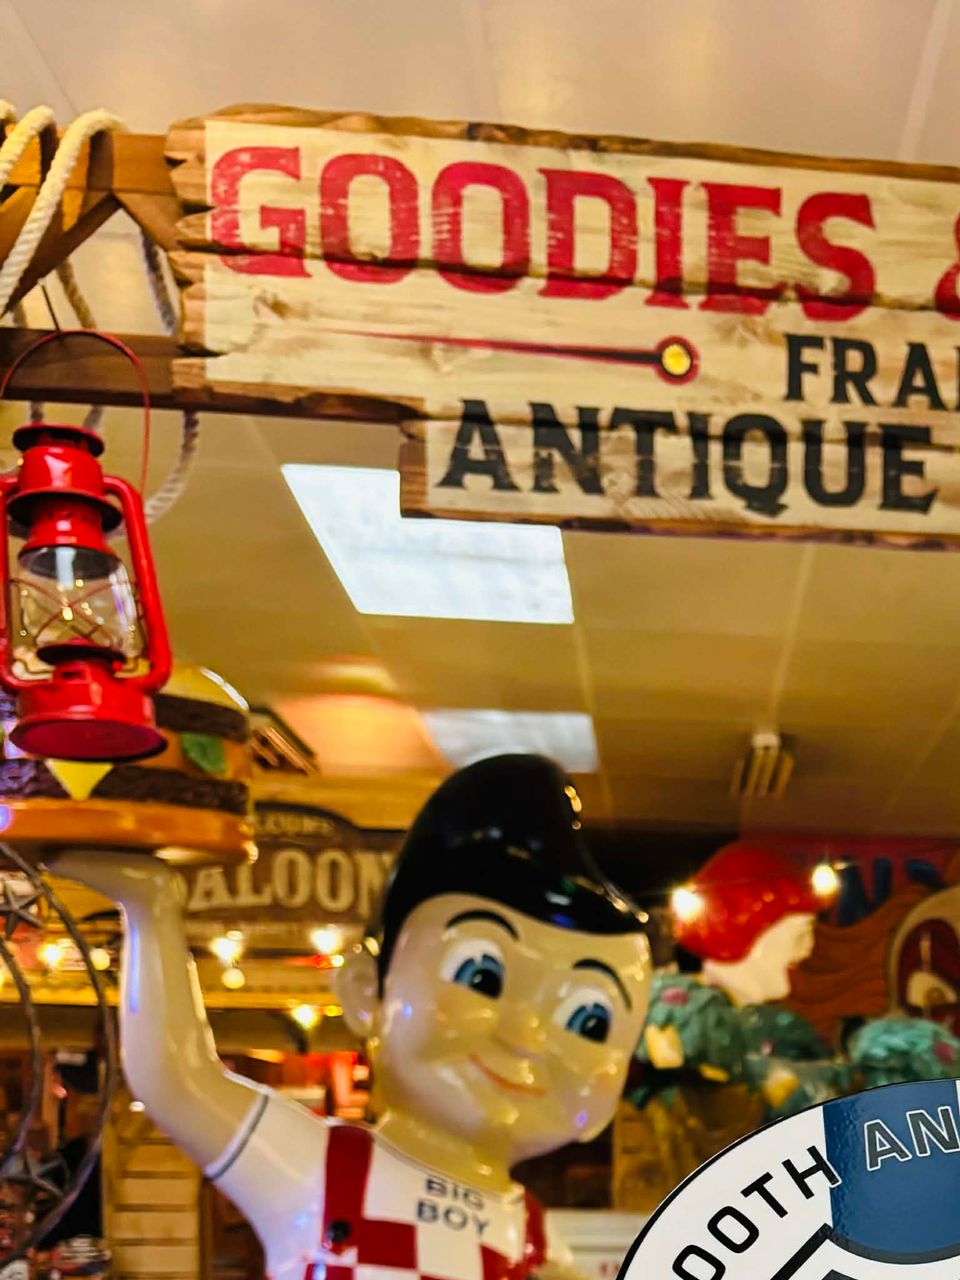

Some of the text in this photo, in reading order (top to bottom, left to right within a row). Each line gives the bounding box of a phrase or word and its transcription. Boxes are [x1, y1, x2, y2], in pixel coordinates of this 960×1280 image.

[210, 144, 877, 323] GOODIES
[435, 399, 939, 518] ANTIQUE
[417, 1198, 489, 1237] BOY
[426, 1178, 484, 1211] BIG
